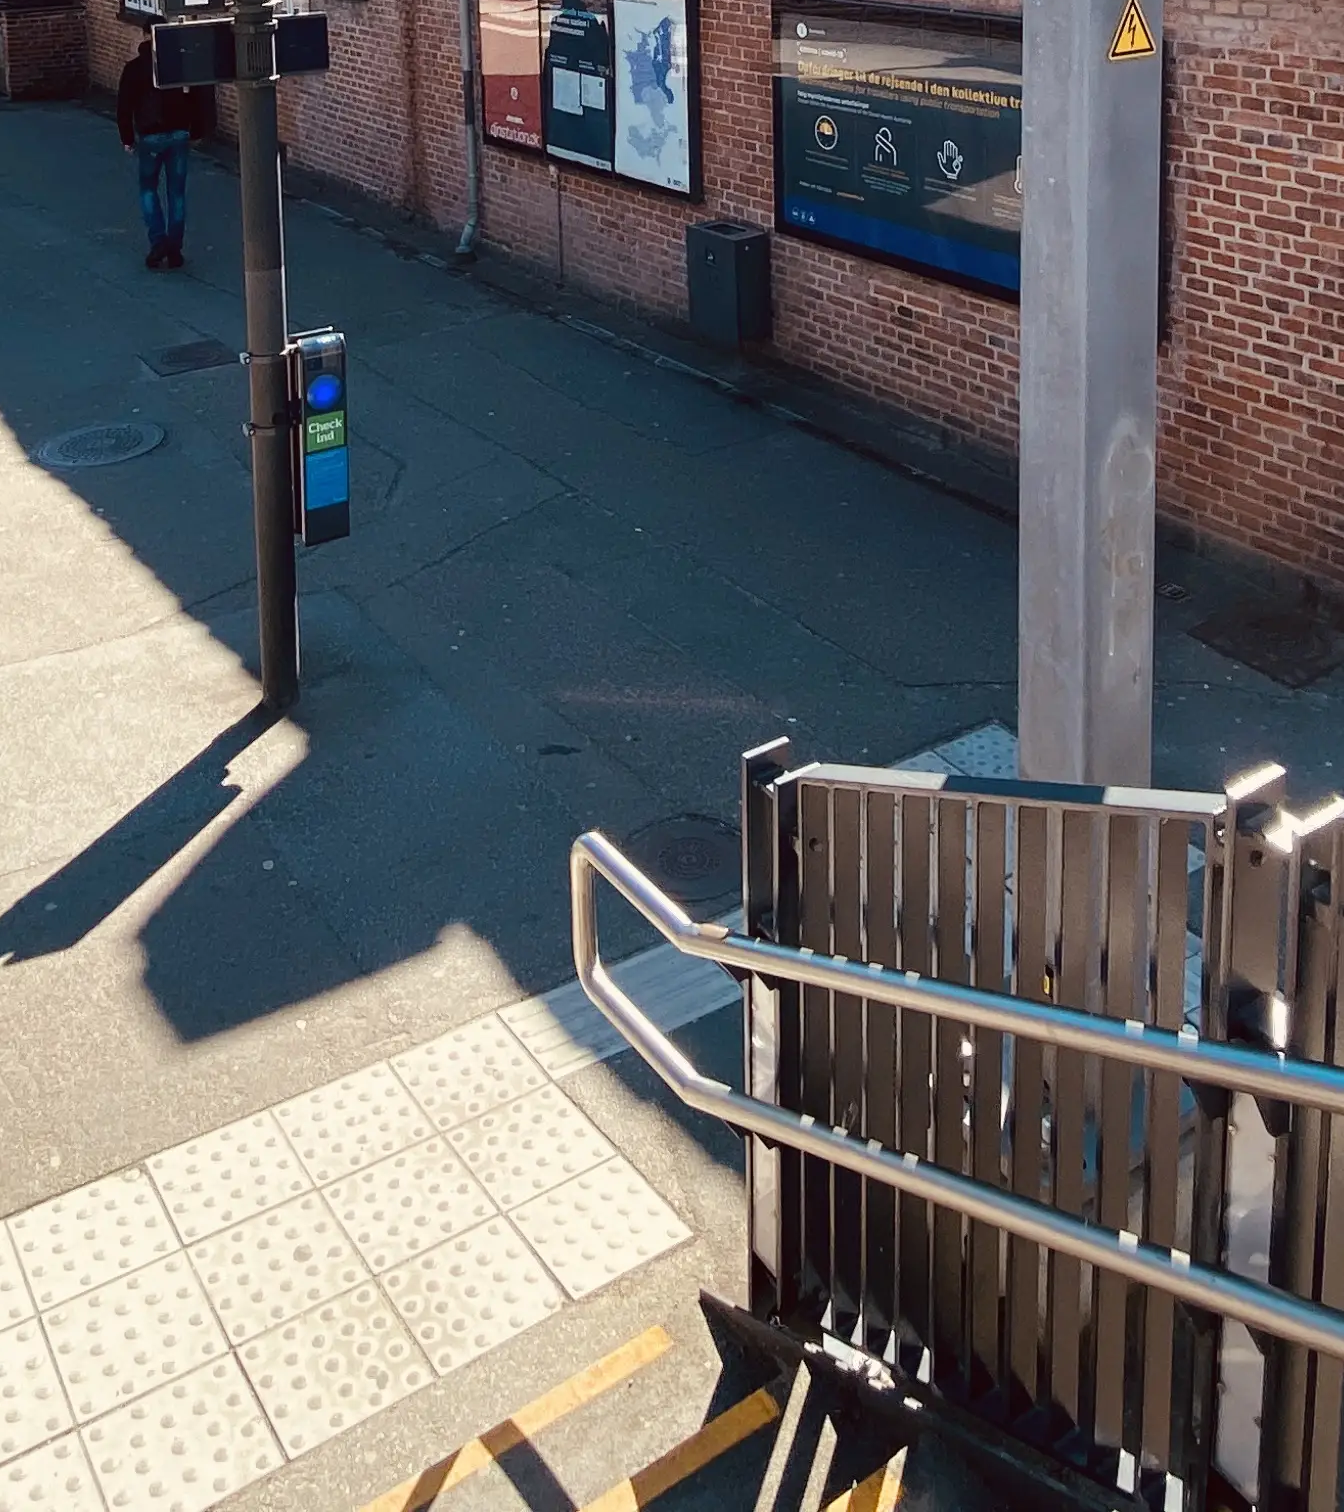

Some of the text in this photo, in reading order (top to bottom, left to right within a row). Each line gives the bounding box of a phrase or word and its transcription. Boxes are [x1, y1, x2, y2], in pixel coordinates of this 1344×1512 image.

[881, 73, 923, 93] rejsende
[930, 83, 950, 97] den
[308, 418, 343, 434] Check
